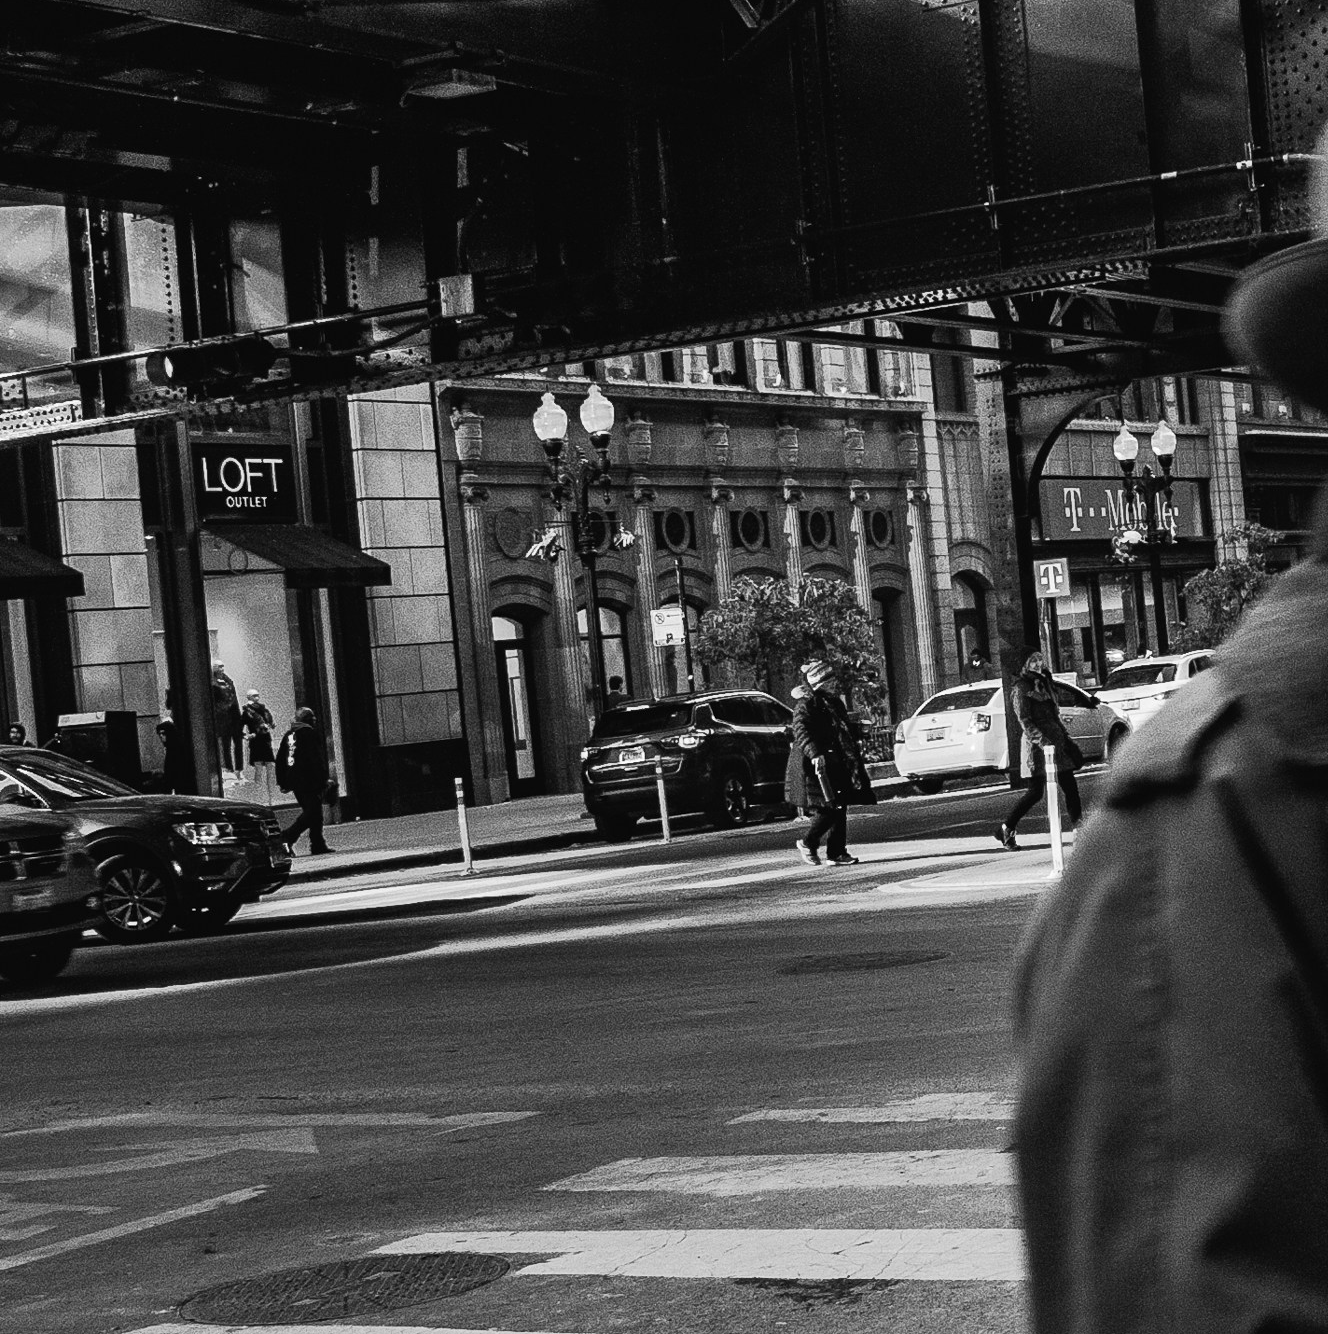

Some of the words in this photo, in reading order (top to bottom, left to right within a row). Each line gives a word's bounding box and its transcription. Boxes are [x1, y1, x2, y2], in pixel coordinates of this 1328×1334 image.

[202, 457, 283, 493] LOFT
[226, 495, 268, 508] OUTLET
[1040, 563, 1063, 594] T
